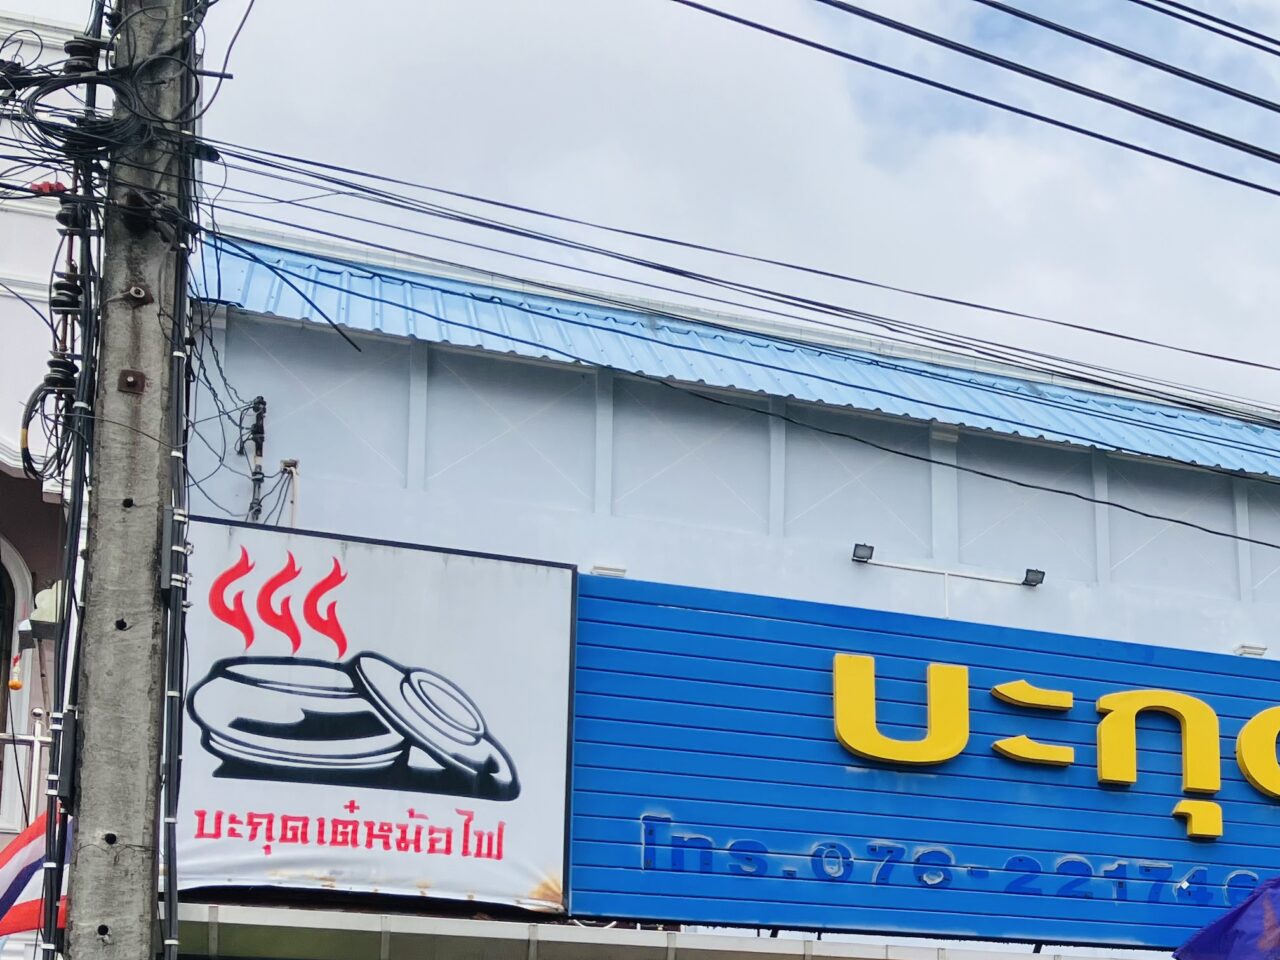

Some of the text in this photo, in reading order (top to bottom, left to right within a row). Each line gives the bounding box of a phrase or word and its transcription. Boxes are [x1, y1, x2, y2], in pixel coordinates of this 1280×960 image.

[194, 800, 505, 861] บะกุดเต๋หม้อไฟ
